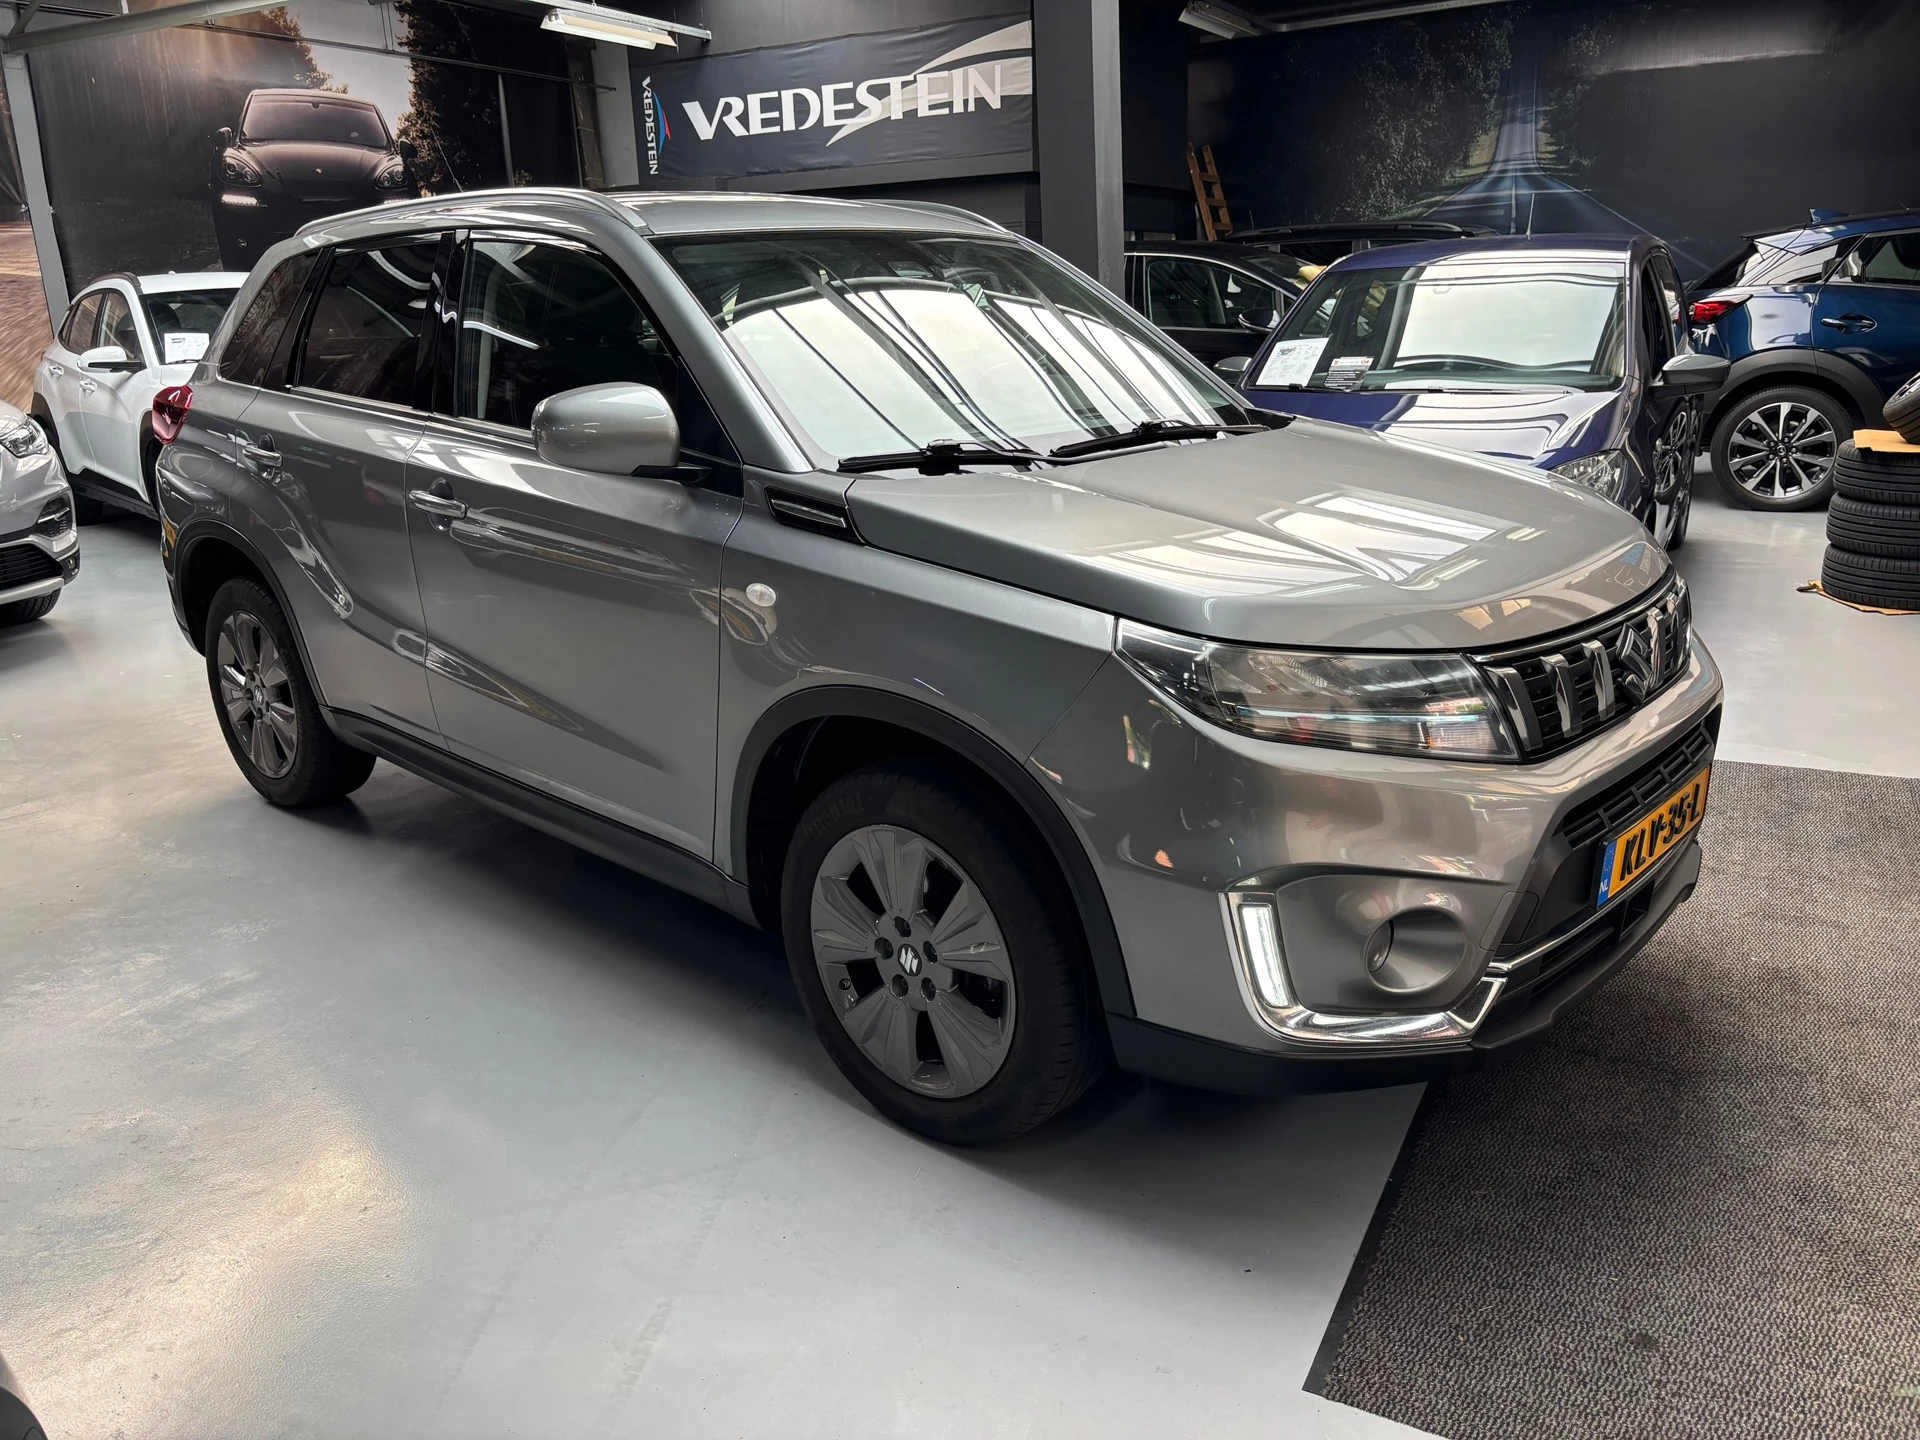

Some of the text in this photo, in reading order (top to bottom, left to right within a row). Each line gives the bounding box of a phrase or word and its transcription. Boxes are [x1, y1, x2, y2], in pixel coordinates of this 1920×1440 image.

[642, 76, 659, 175] VREDESTEIN
[682, 64, 1002, 145] VREDESTEIN
[1619, 783, 1701, 882] KLV-35-L
[1599, 879, 1609, 895] NL
